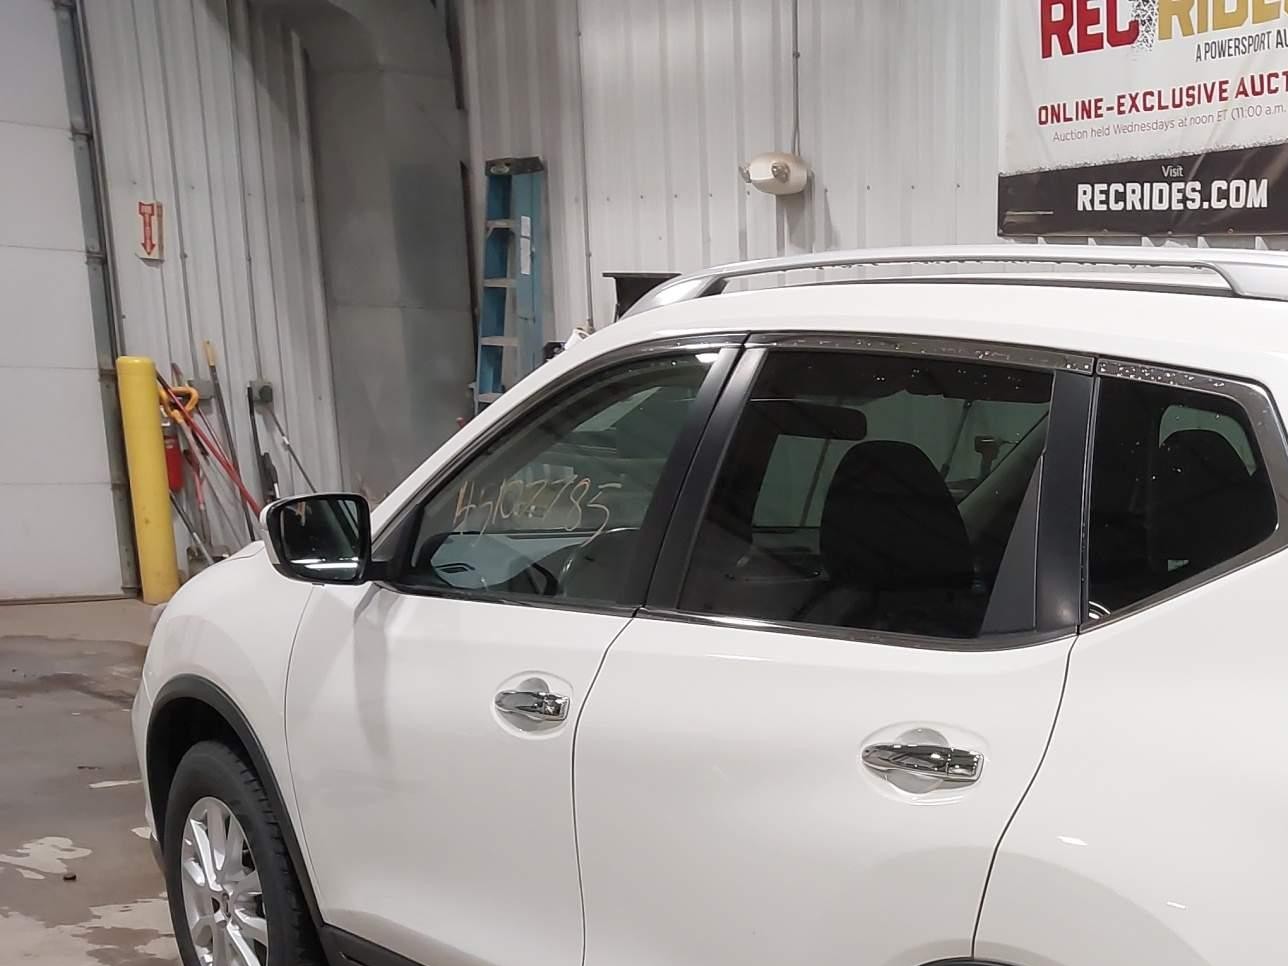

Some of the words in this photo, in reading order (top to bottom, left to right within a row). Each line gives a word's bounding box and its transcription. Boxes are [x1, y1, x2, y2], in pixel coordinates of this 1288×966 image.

[1196, 44, 1202, 63] A
[1204, 31, 1273, 60] POWERSPORT
[1038, 79, 1229, 125] ONLINE-EXCLUSIVE
[1053, 128, 1088, 142] Auction
[1091, 125, 1110, 138] held
[1112, 119, 1175, 135] Wednesdays
[1178, 118, 1188, 128] at
[1190, 114, 1214, 126] noon
[1217, 109, 1228, 122] ET
[1162, 165, 1184, 178] Visit
[1077, 179, 1268, 211] RECRIDES.COM
